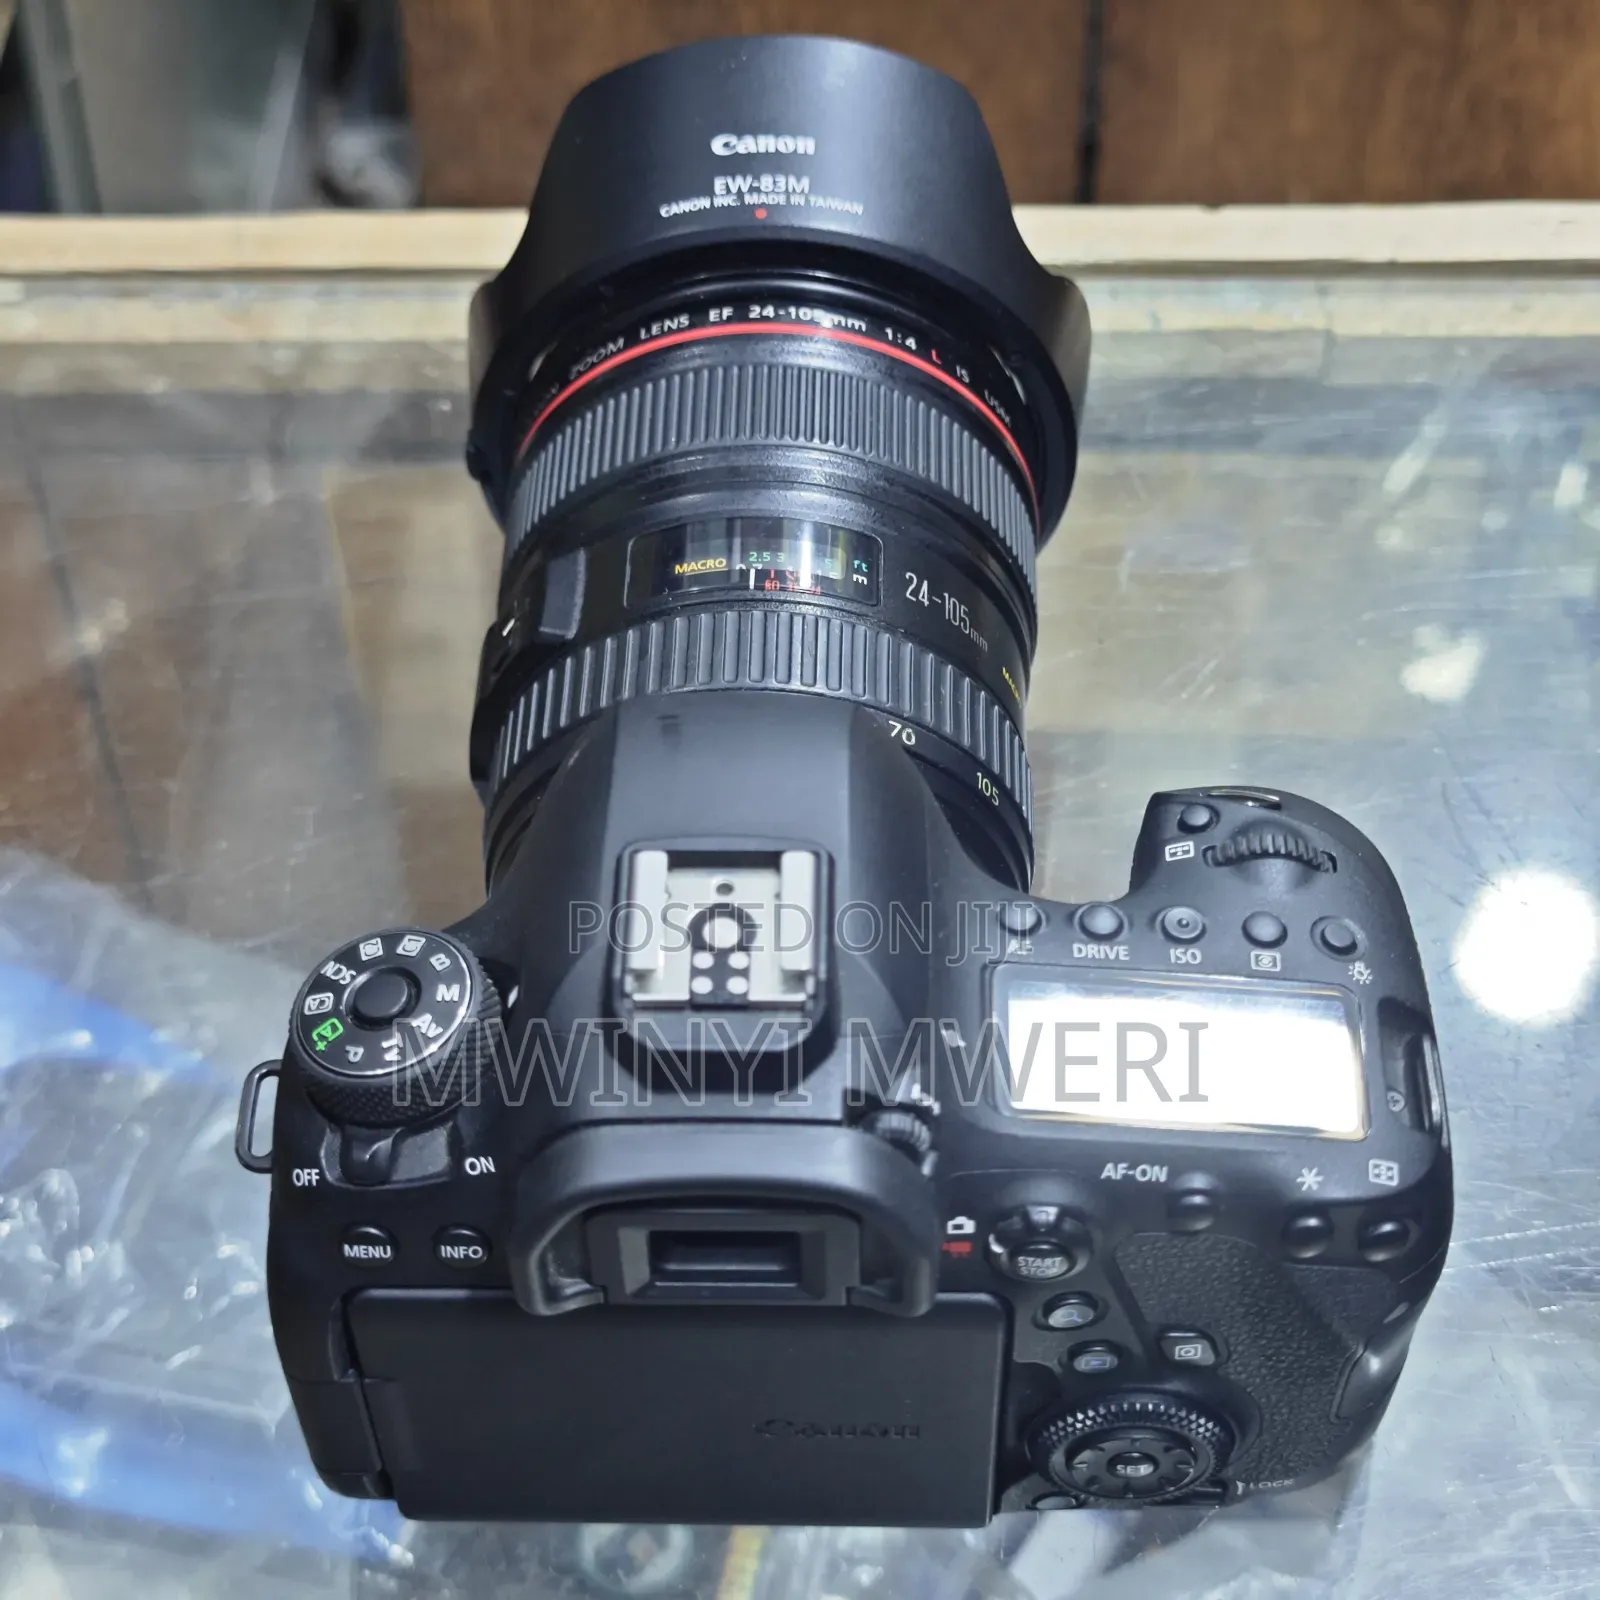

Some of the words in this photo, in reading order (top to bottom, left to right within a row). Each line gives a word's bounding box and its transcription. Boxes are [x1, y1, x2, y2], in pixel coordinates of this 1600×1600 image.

[710, 133, 816, 156] Canon
[713, 174, 810, 195] EW-83M
[659, 195, 711, 218] CANON
[713, 194, 741, 207] INC.
[744, 193, 787, 206] MADE
[790, 194, 806, 206] IN
[809, 196, 864, 215] TAIWAN
[639, 313, 690, 340] LENS
[708, 307, 734, 322] EF
[884, 326, 918, 350] 1:4
[931, 347, 942, 365] L
[956, 364, 970, 384] IS
[675, 557, 728, 575] MACRO
[749, 552, 771, 562] 2.5
[777, 552, 785, 563] 3
[905, 572, 988, 652] 24-105mm
[888, 720, 916, 745] 70
[976, 772, 999, 806] 105
[1072, 943, 1130, 961] DRIVE
[1169, 949, 1202, 965] ISO
[429, 953, 451, 972] B
[320, 961, 357, 985] SCN
[436, 984, 460, 1002] M
[411, 1013, 444, 1038] Av
[345, 1045, 365, 1063] P
[464, 1156, 496, 1176] ON
[1101, 1162, 1169, 1182] AF-ON
[292, 1168, 320, 1186] OFF
[343, 1244, 391, 1259] MENU
[440, 1245, 483, 1259] INFO
[1018, 1256, 1063, 1268] START
[1020, 1266, 1058, 1276] STOP
[1116, 1463, 1150, 1475] SET
[1249, 1478, 1295, 1489] LOCK
